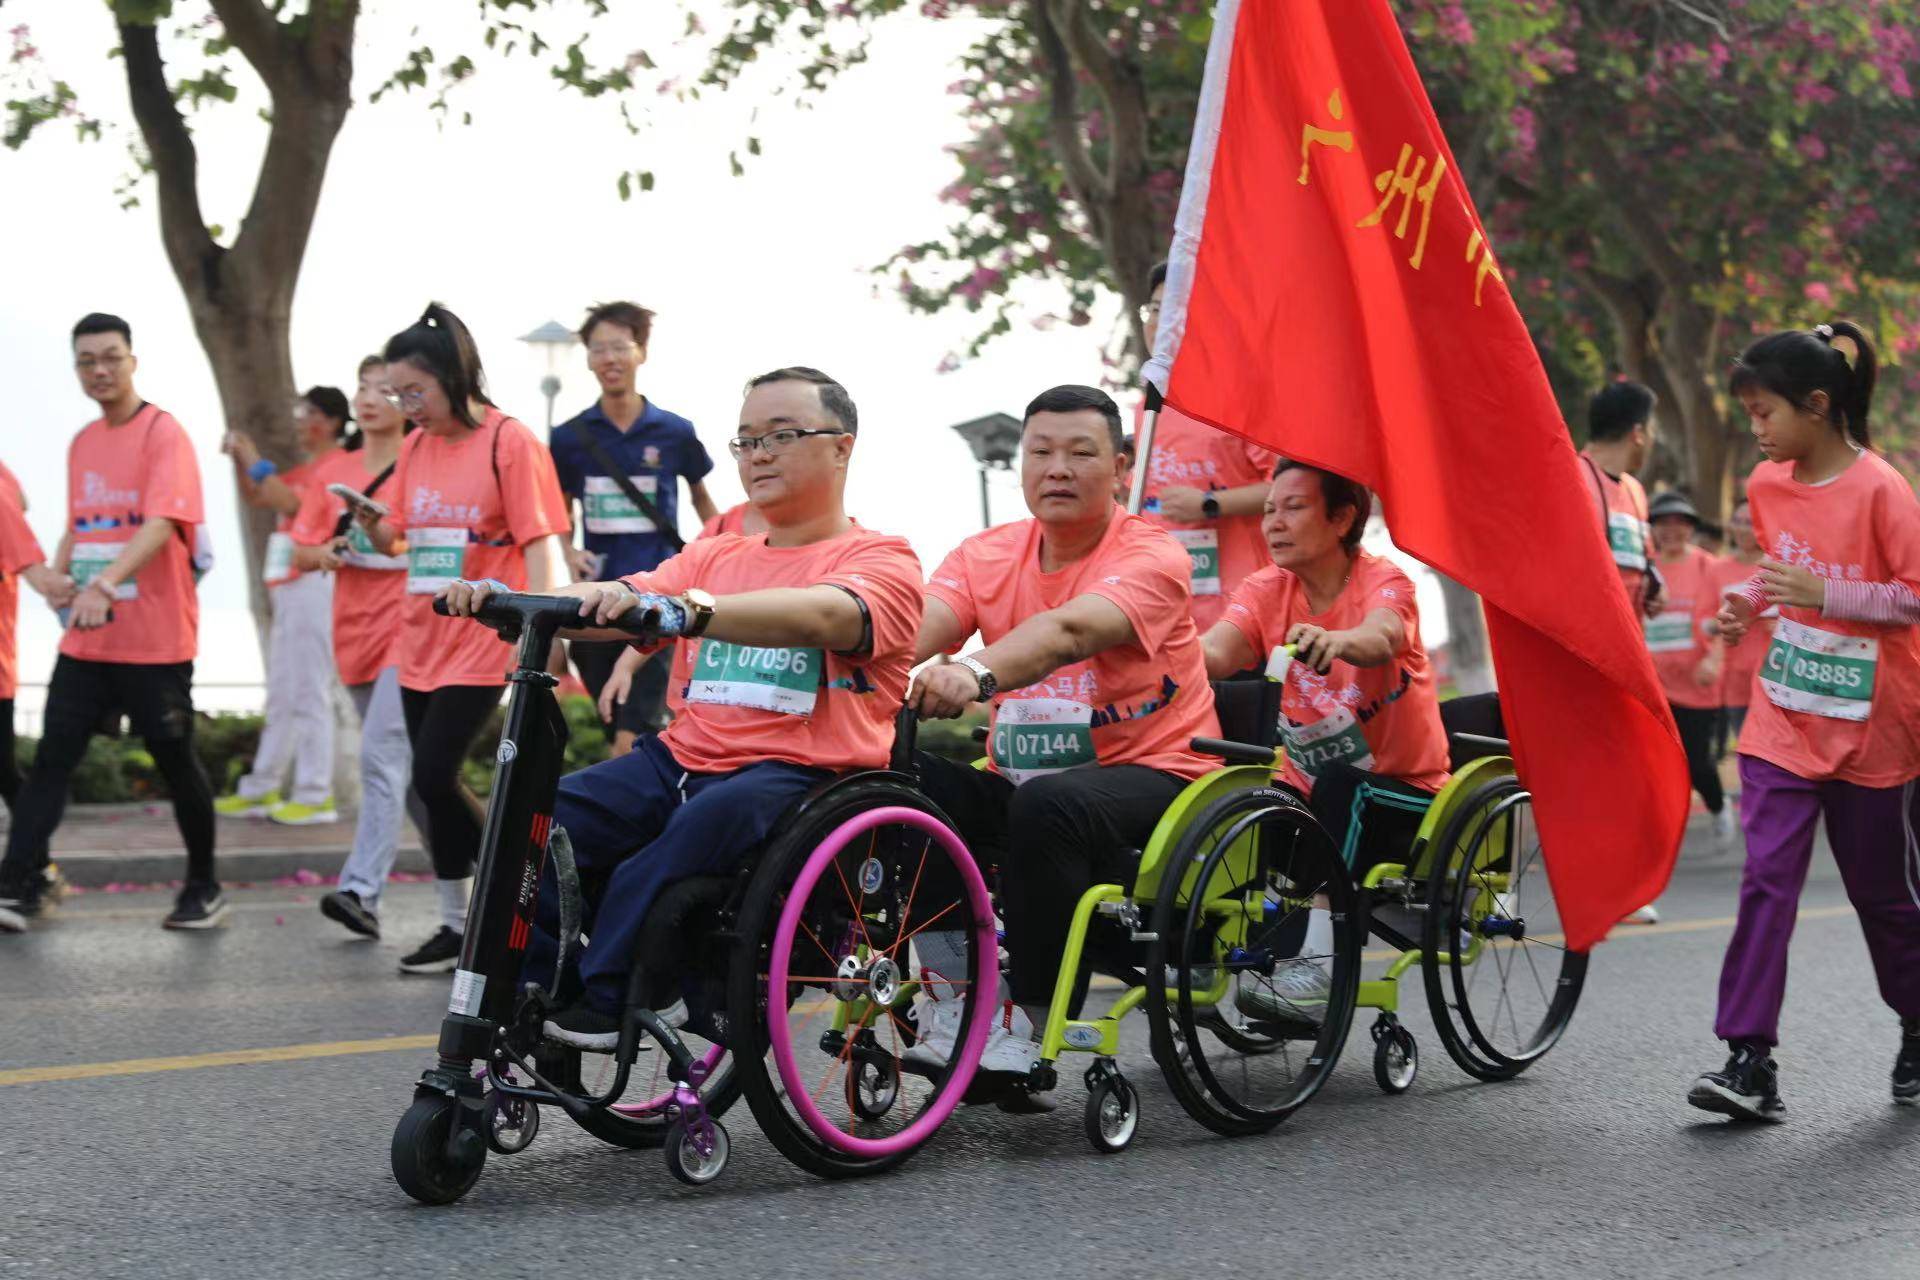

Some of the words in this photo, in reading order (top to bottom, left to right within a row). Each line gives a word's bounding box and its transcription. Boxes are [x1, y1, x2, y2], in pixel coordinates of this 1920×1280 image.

[705, 641, 721, 668] C
[737, 646, 809, 675] 07096
[1768, 646, 1785, 671] C
[1792, 656, 1862, 688] 03885
[995, 730, 1007, 756] C
[1015, 732, 1081, 756] 07144
